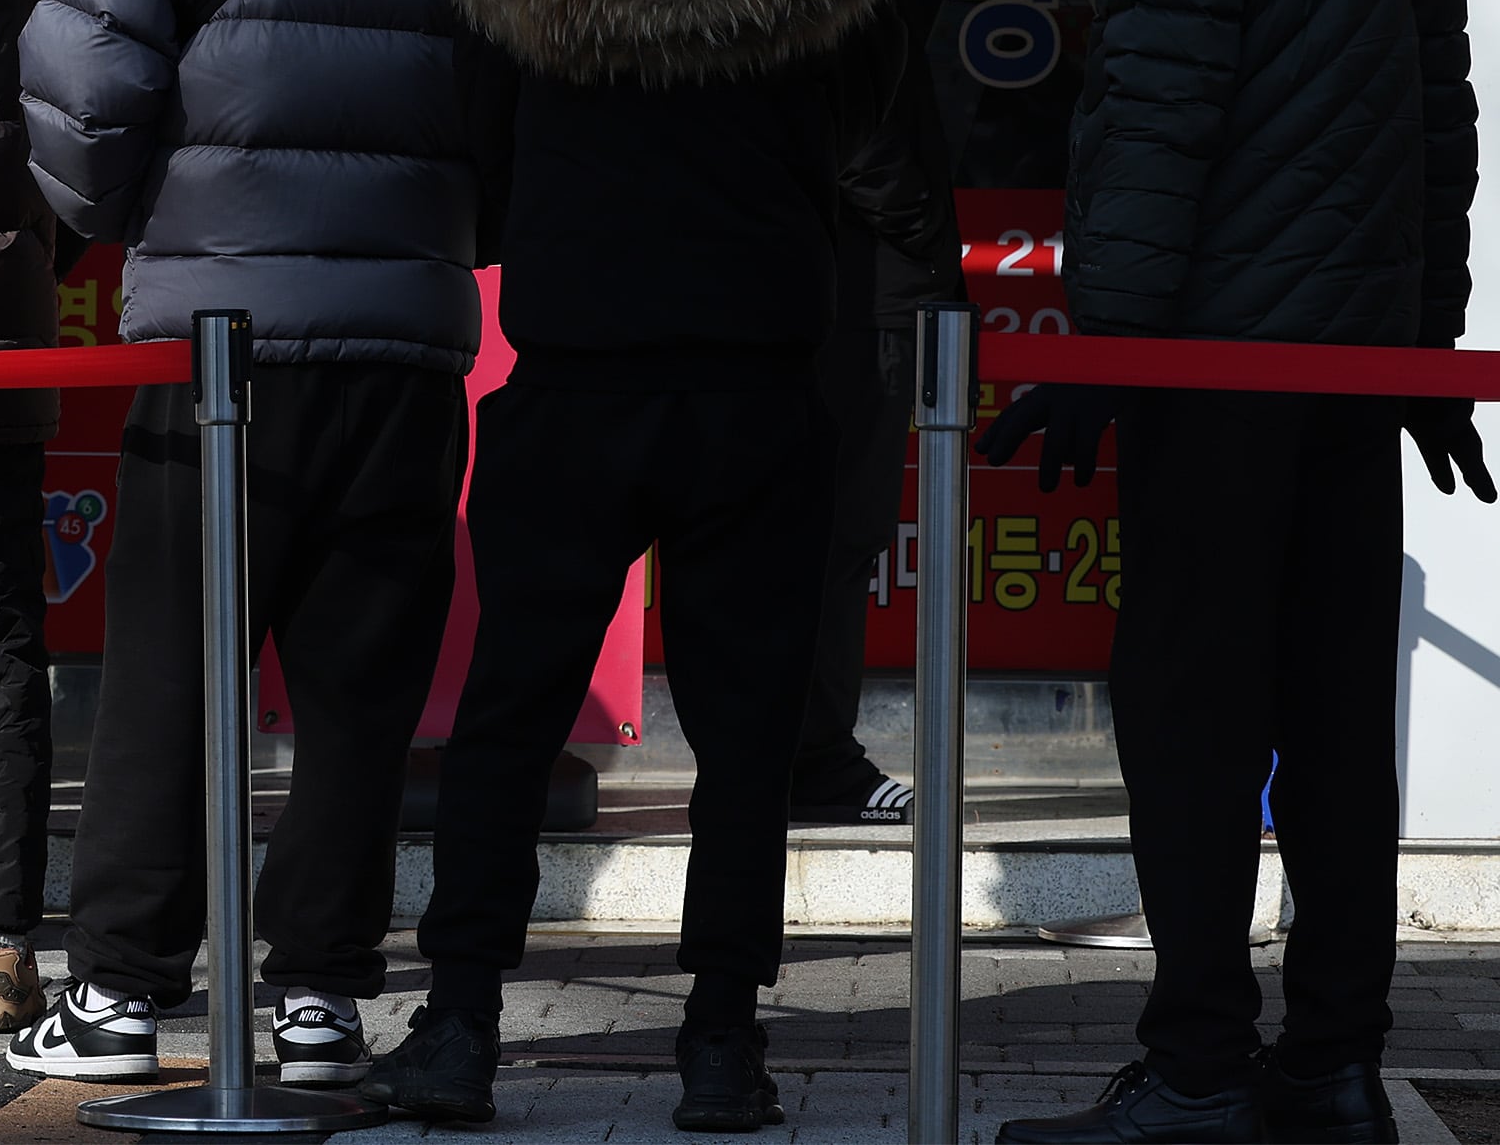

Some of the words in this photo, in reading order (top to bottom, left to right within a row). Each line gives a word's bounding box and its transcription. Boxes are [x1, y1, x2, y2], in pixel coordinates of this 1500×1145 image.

[860, 809, 902, 821] adidas
[125, 1000, 151, 1015] NIKE
[297, 1009, 326, 1023] NIKE
